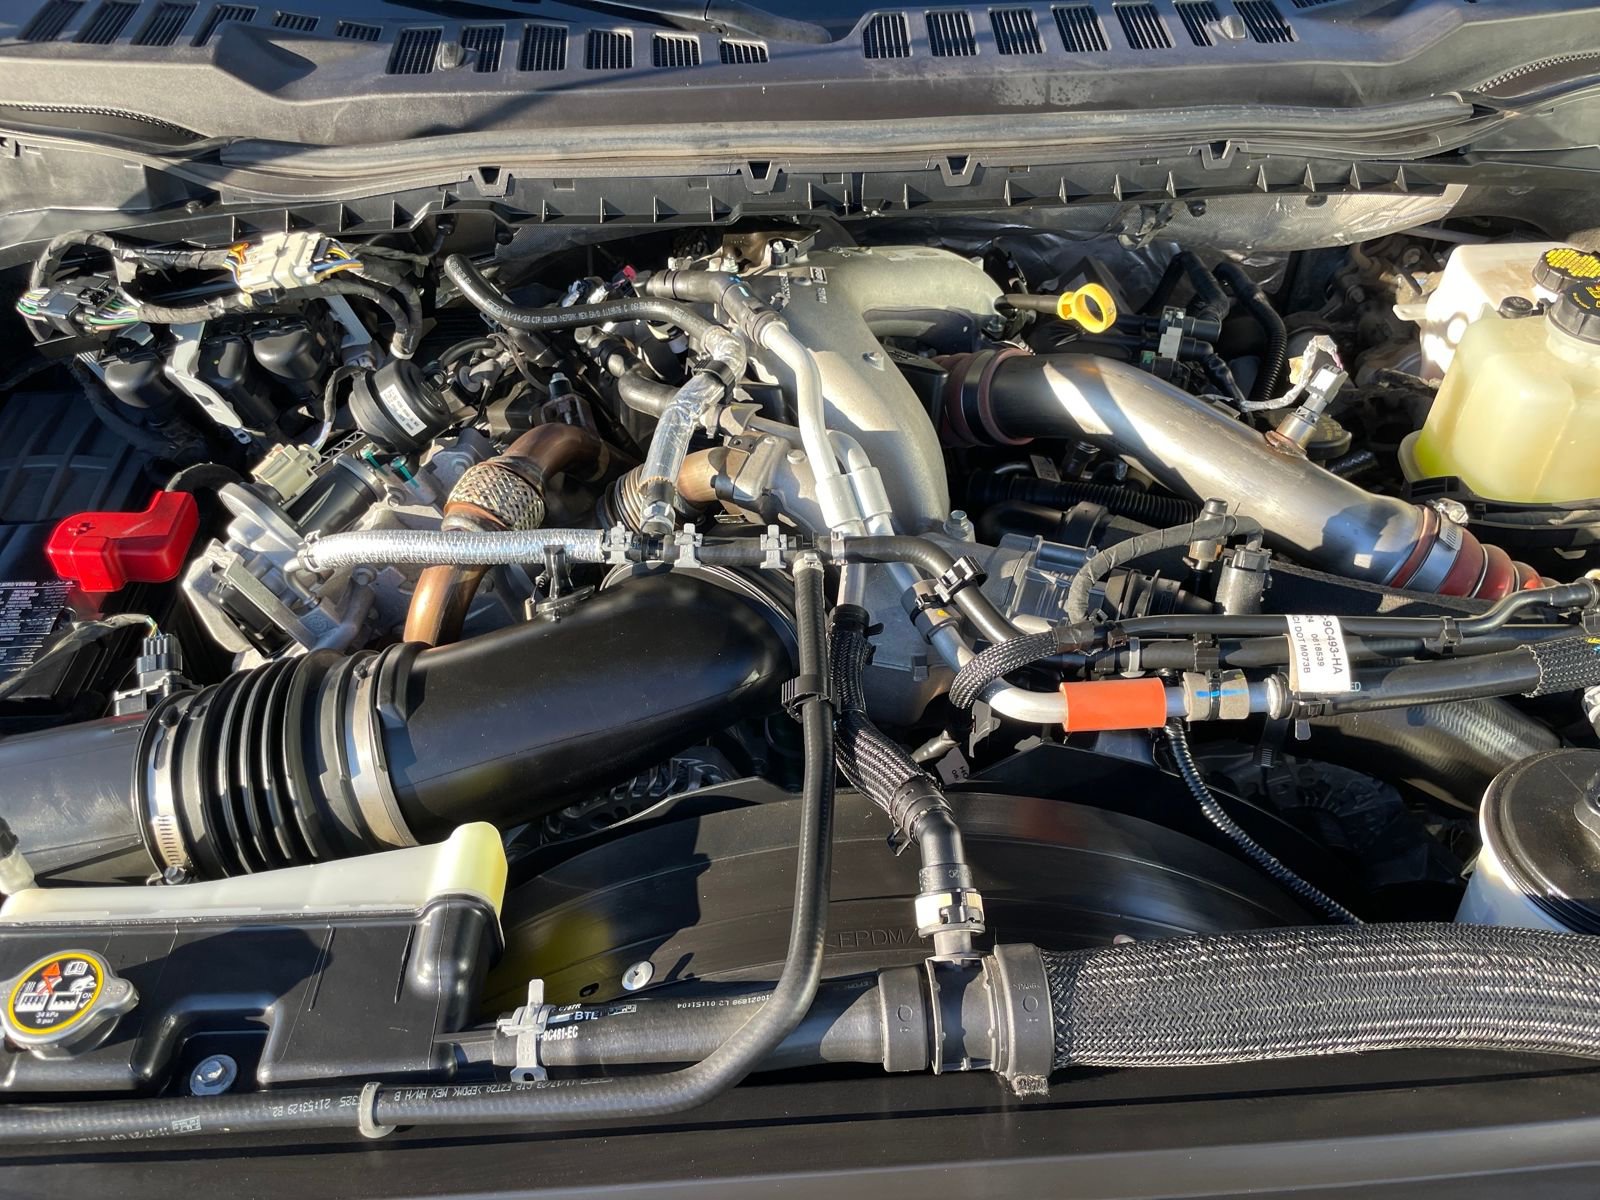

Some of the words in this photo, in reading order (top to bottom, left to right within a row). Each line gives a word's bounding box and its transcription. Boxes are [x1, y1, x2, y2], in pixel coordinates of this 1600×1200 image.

[1295, 626, 1306, 643] DOT
[1322, 615, 1343, 675] -9C493-HA
[1300, 644, 1311, 674] M073B
[431, 1087, 448, 1098] MEX
[287, 1098, 331, 1116] 21:53:29
